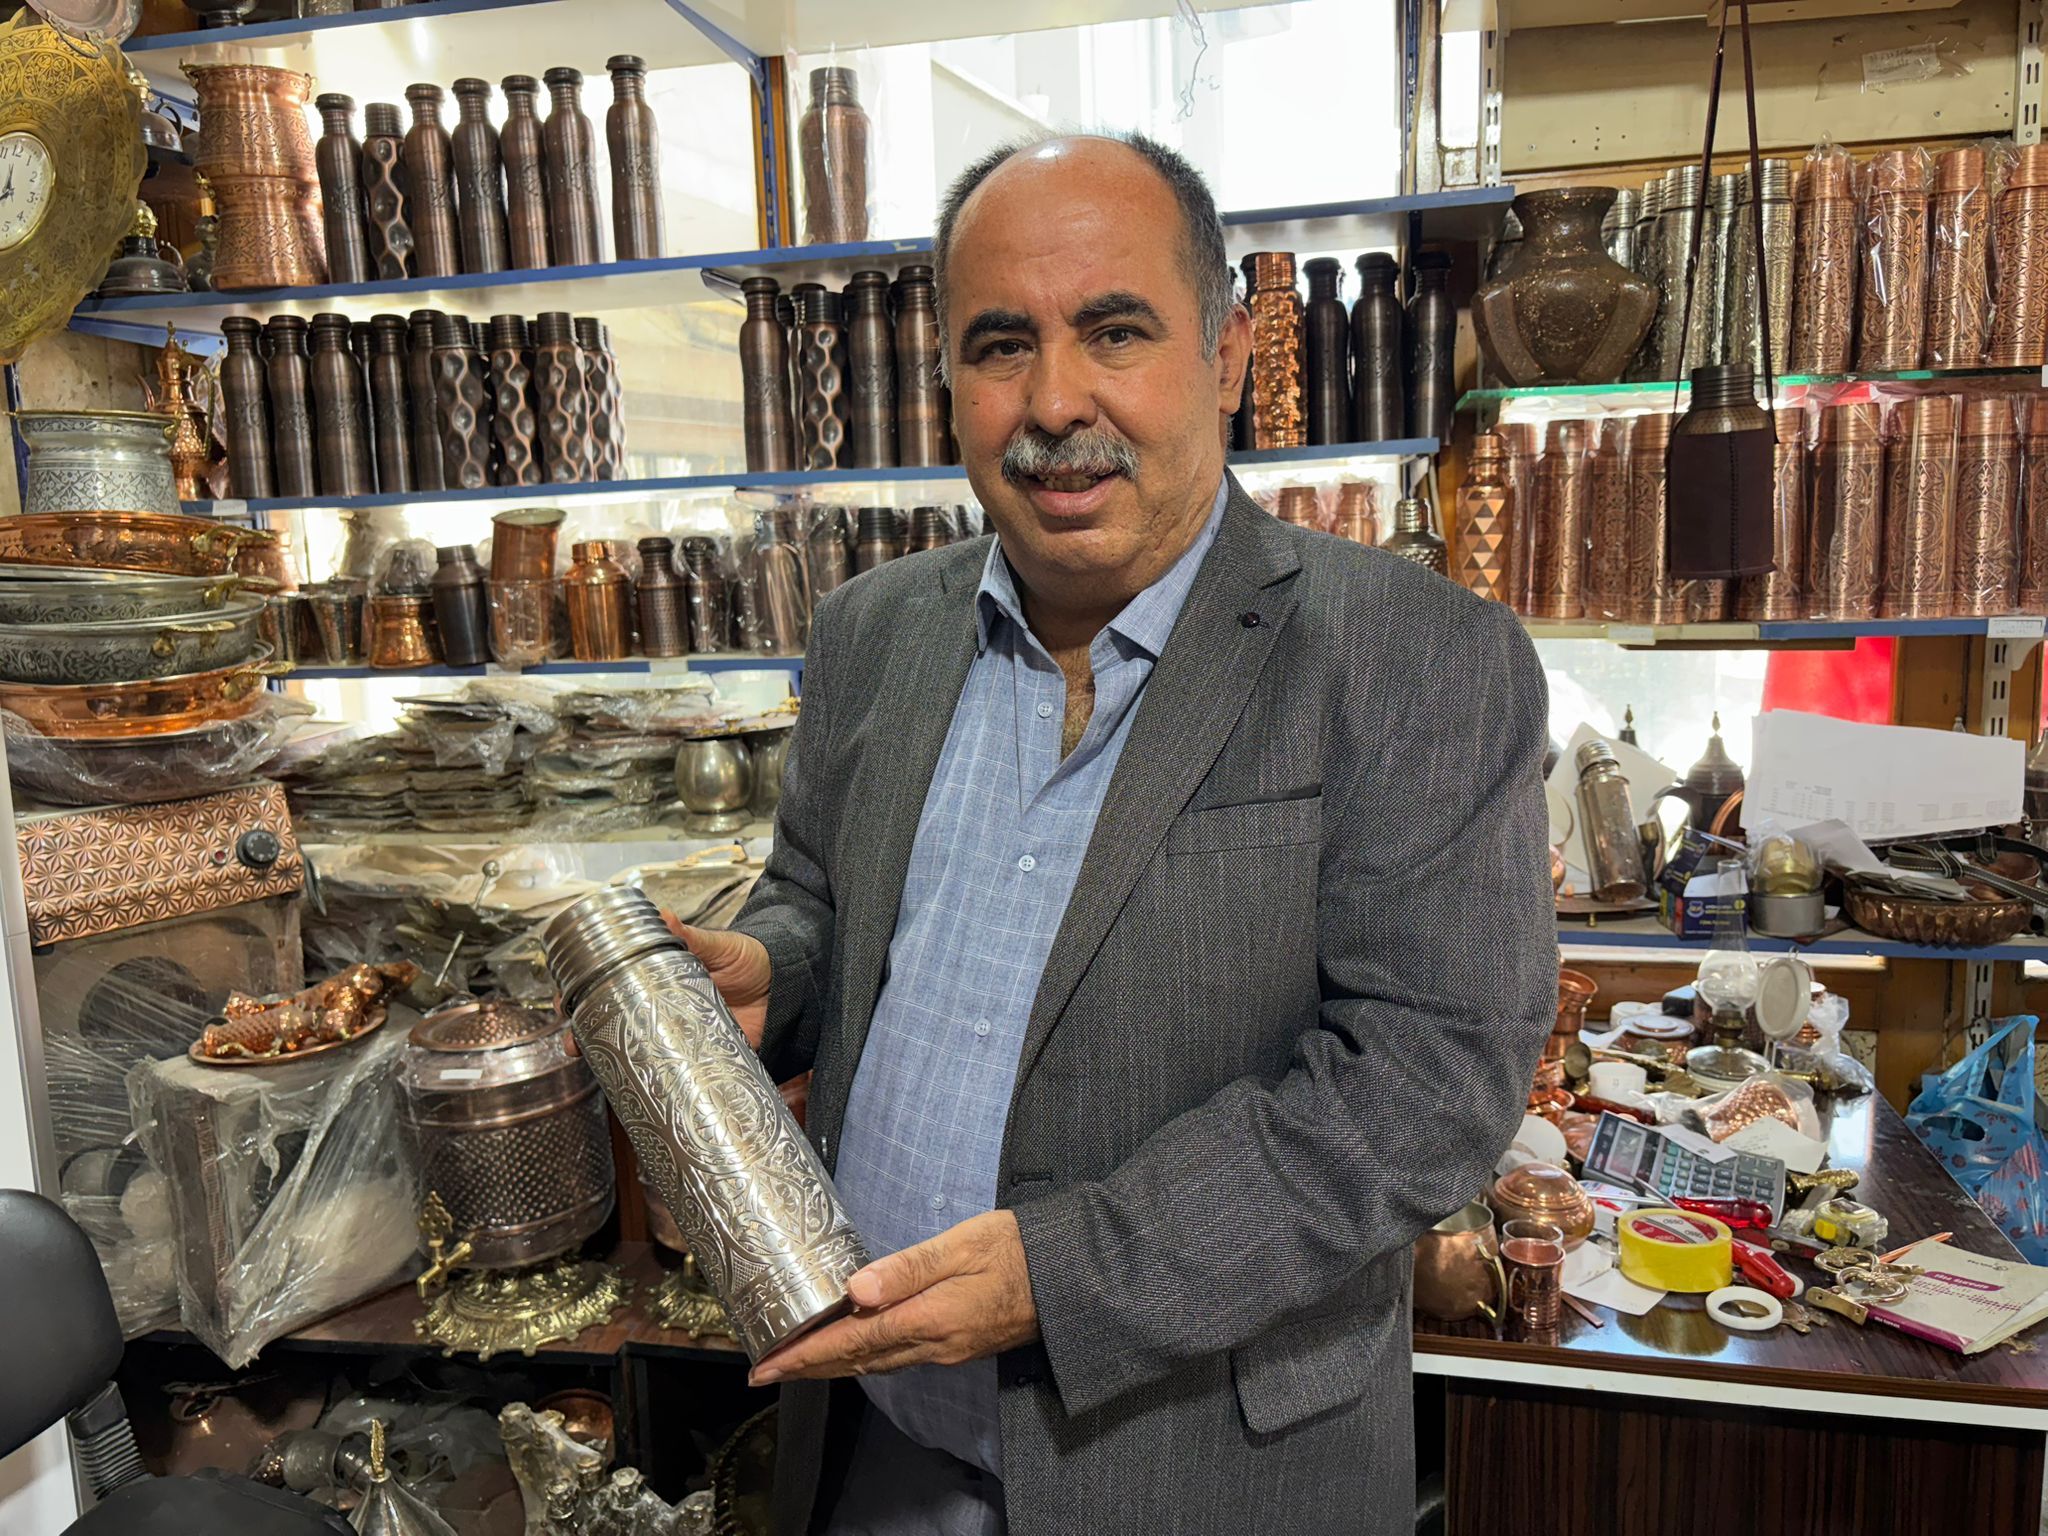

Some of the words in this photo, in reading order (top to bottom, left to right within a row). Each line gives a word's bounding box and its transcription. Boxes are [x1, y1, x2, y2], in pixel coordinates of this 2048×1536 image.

[12, 144, 24, 158] 12
[26, 155, 32, 166] 1
[29, 171, 38, 183] 2
[26, 192, 36, 204] 3
[17, 211, 24, 221] 4
[2, 221, 11, 232] 5
